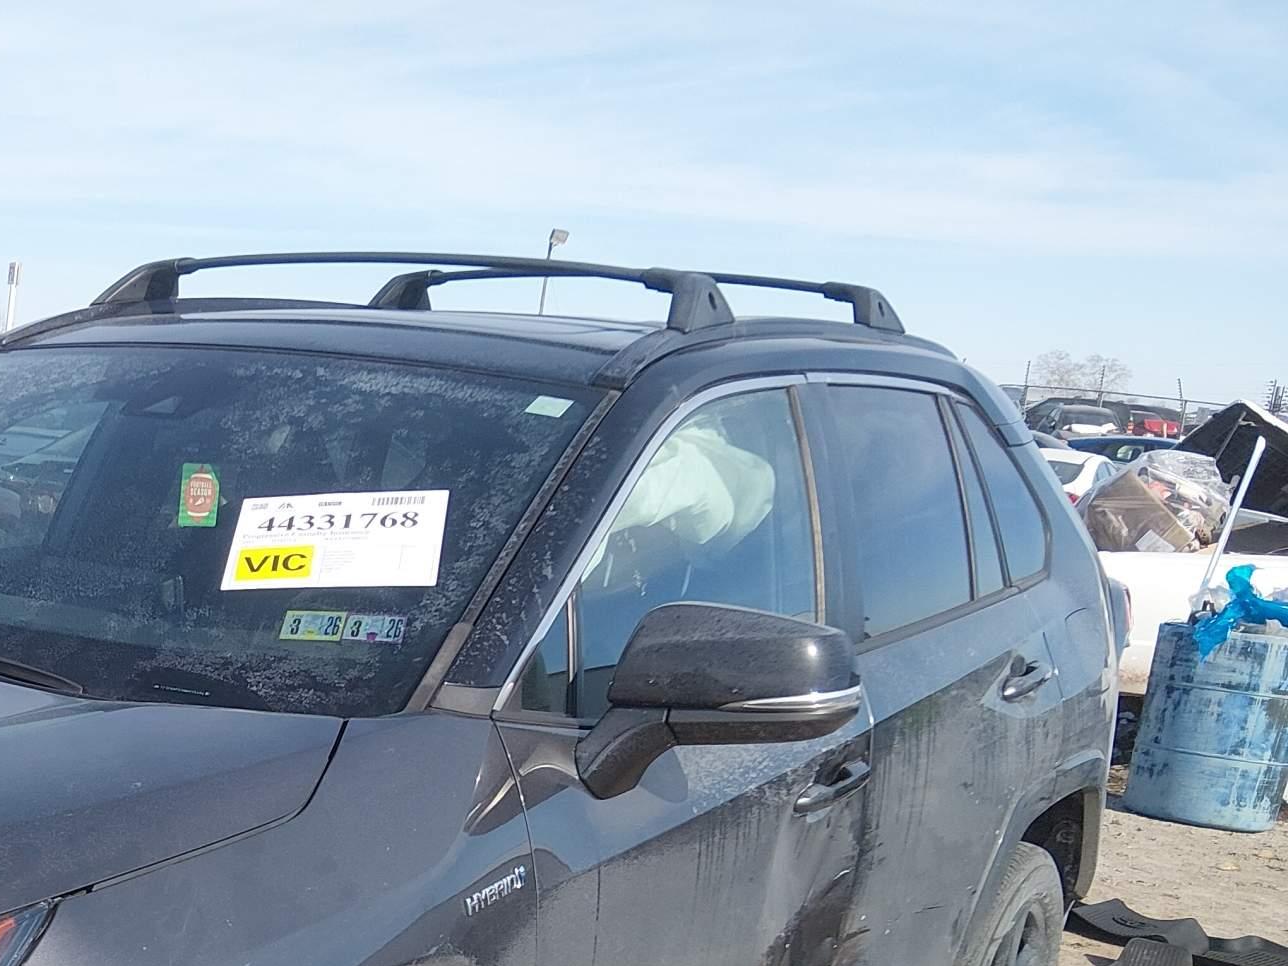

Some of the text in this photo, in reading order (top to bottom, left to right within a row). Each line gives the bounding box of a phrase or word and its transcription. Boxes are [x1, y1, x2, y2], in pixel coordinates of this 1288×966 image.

[257, 511, 419, 532] 44331768
[244, 553, 308, 573] VIC
[324, 616, 342, 636] 26
[386, 618, 403, 639] 26
